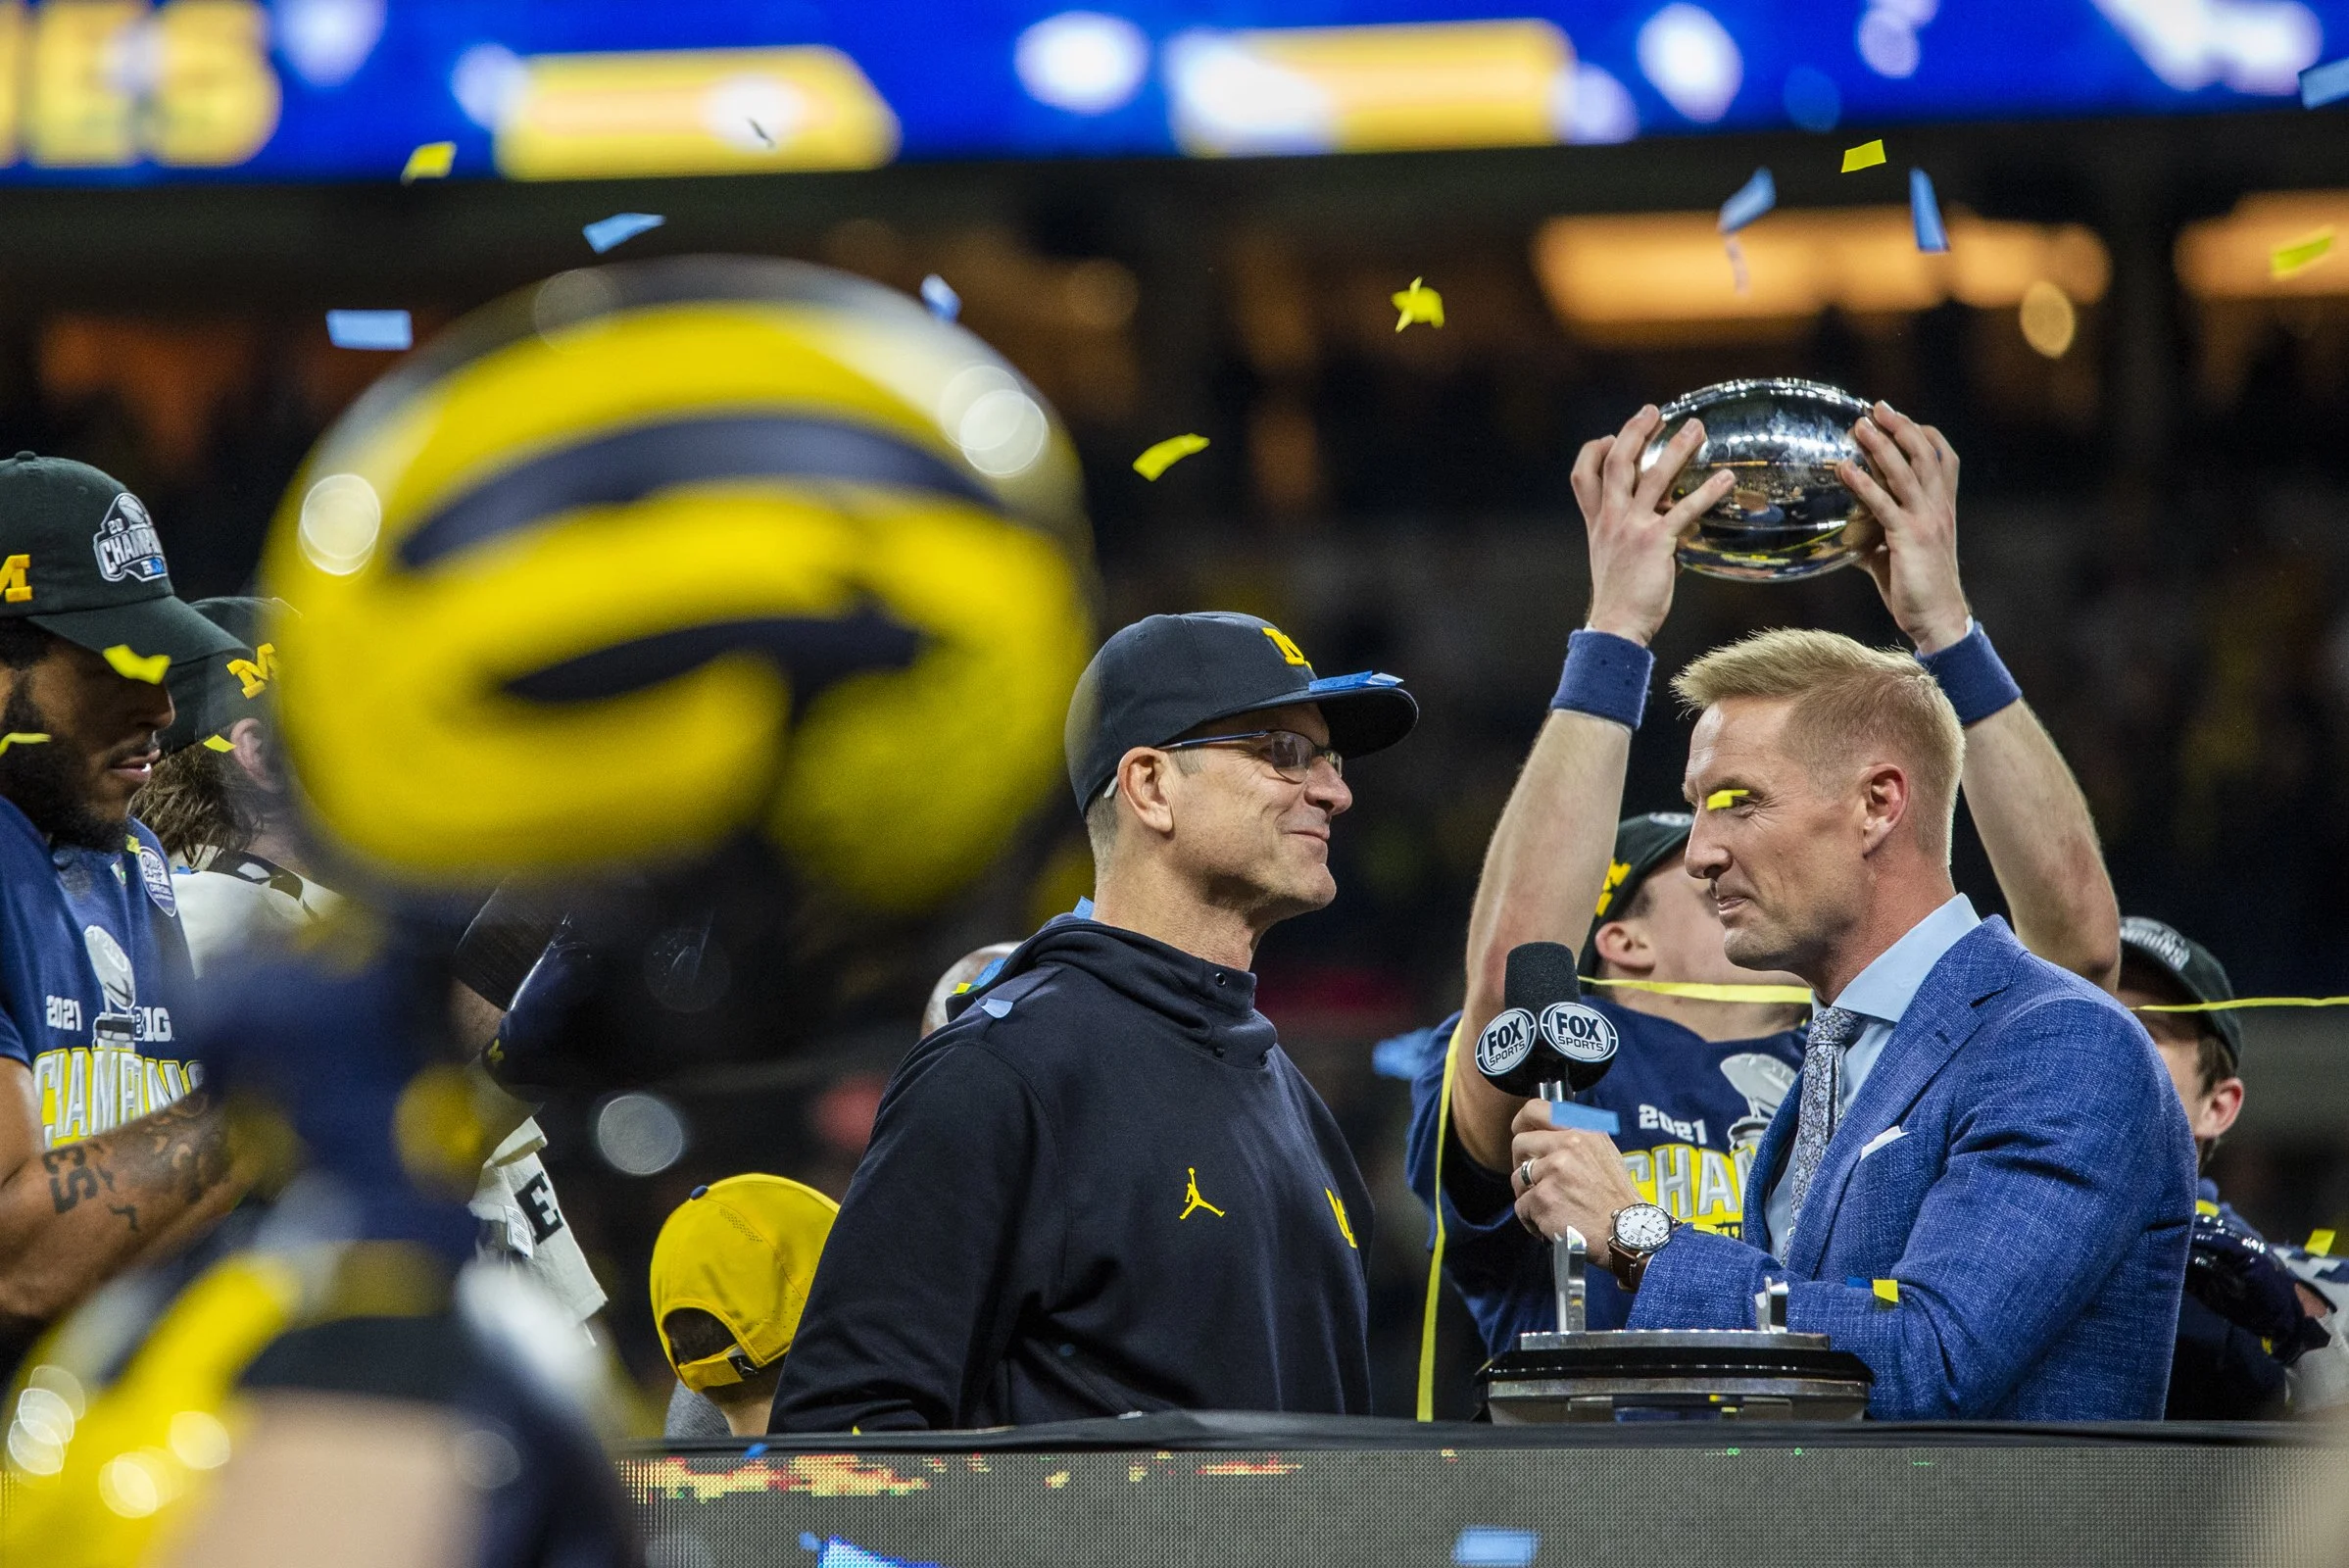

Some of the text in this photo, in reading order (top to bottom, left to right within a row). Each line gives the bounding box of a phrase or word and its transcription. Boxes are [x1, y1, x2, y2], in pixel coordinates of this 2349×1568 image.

[46, 995, 82, 1031] 2021
[1555, 1011, 1602, 1042] FOX
[1488, 1016, 1524, 1056] FOX
[1558, 1035, 1604, 1053] SPORTS
[1490, 1041, 1525, 1066] SPORTS
[1639, 1103, 1707, 1145] 2021
